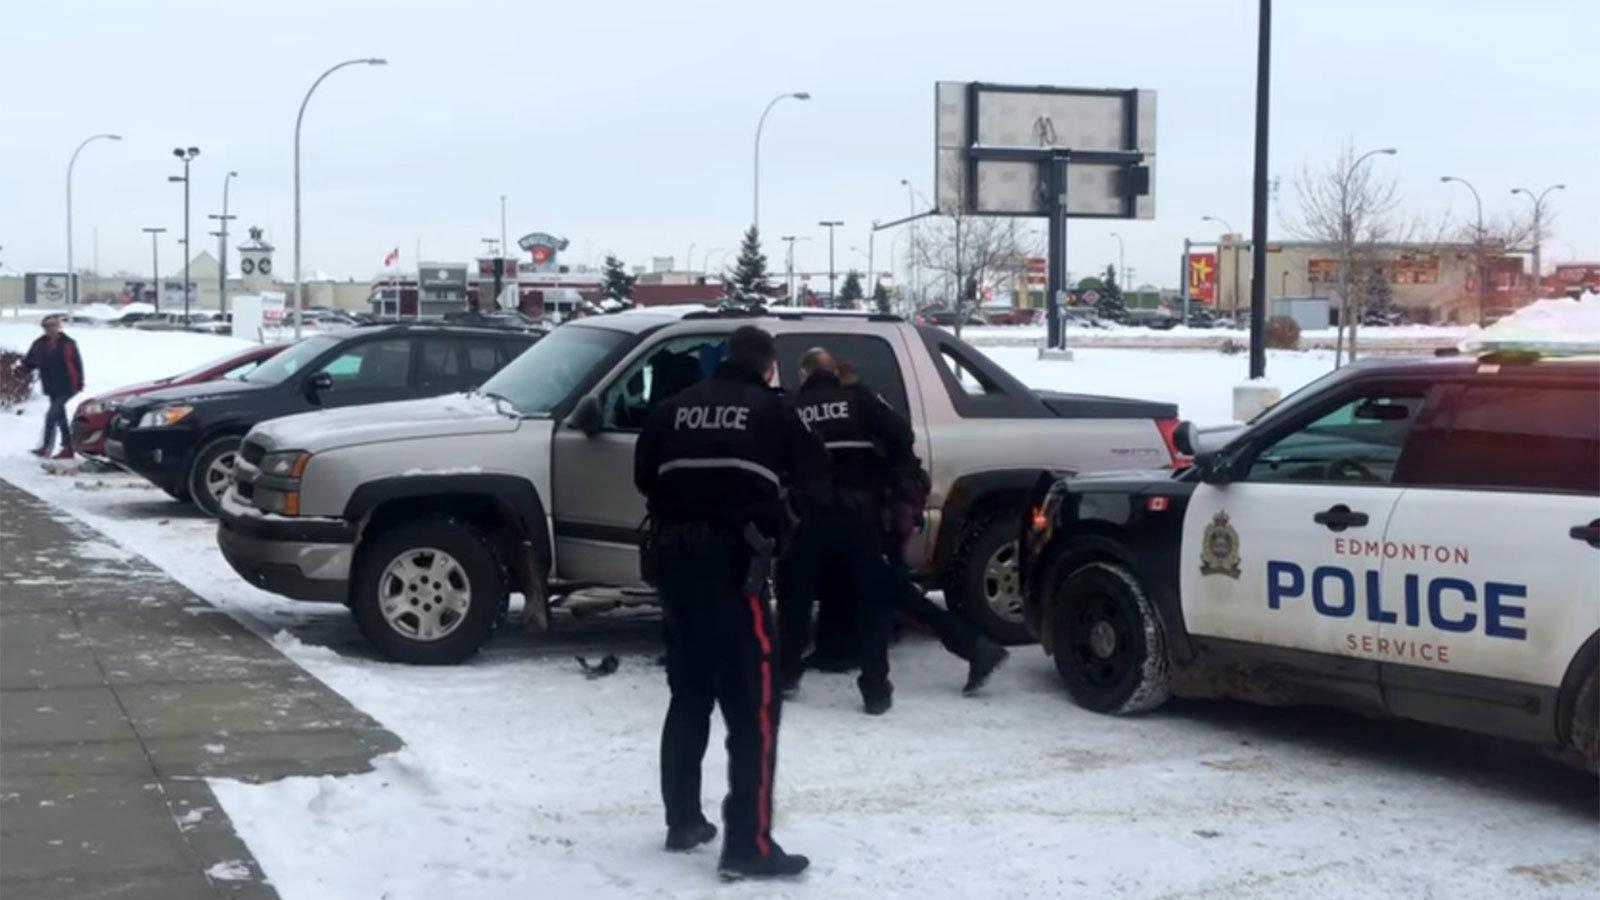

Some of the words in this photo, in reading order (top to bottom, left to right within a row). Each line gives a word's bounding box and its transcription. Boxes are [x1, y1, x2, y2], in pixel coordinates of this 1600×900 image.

[675, 406, 750, 430] POLICE
[1334, 538, 1470, 564] EDMONTON
[1267, 560, 1527, 640] POLICE
[1347, 634, 1449, 662] SERVICE
